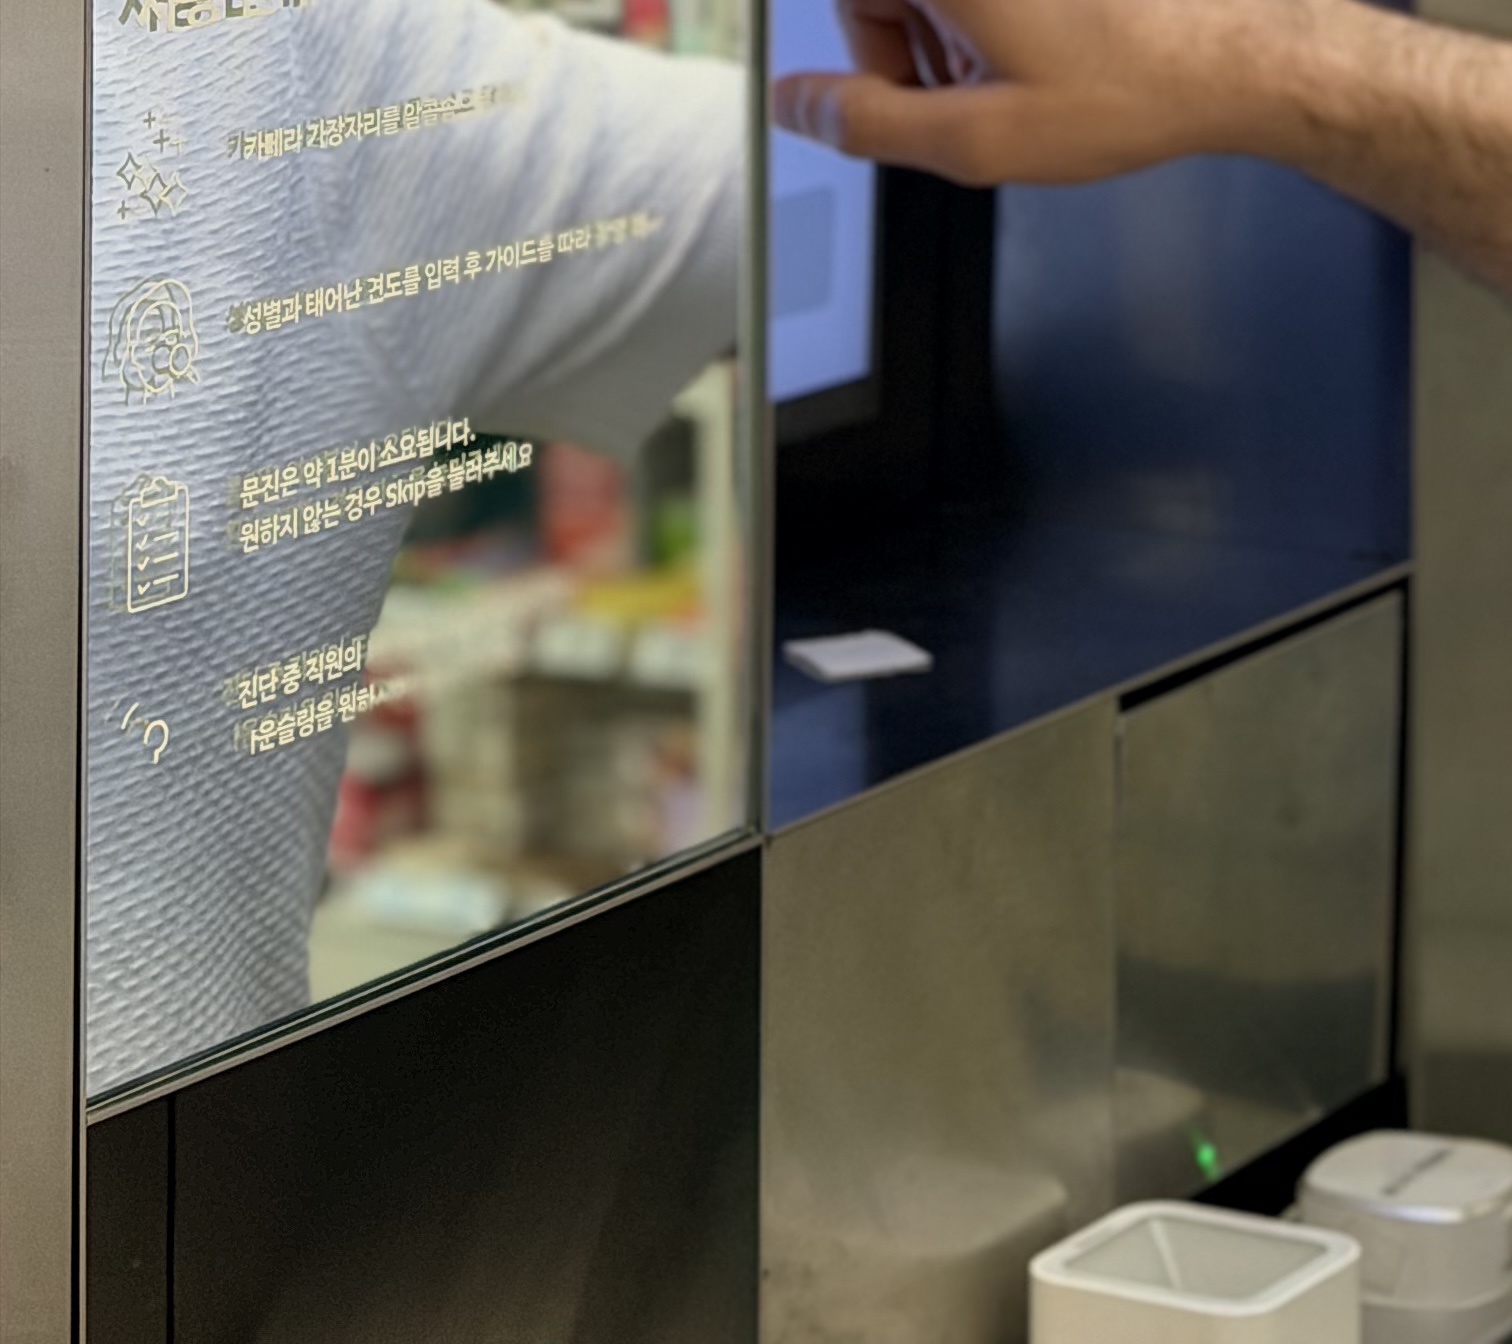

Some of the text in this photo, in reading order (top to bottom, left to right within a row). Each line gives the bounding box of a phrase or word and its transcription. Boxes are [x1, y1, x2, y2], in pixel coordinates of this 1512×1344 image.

[306, 106, 400, 148] 가장자리를
[243, 291, 303, 335] 성별과
[306, 278, 362, 318] 태어난
[424, 255, 460, 291] 입력
[464, 250, 482, 281] 후
[485, 237, 555, 273] 가이드를
[557, 226, 591, 253] 따라
[240, 417, 477, 509] 문진은 약 1분이 소요됩니다.
[239, 507, 298, 554] 원하지
[302, 499, 342, 535] 않는
[344, 486, 383, 521] 경우
[238, 640, 362, 709] 진단 중 직원의
